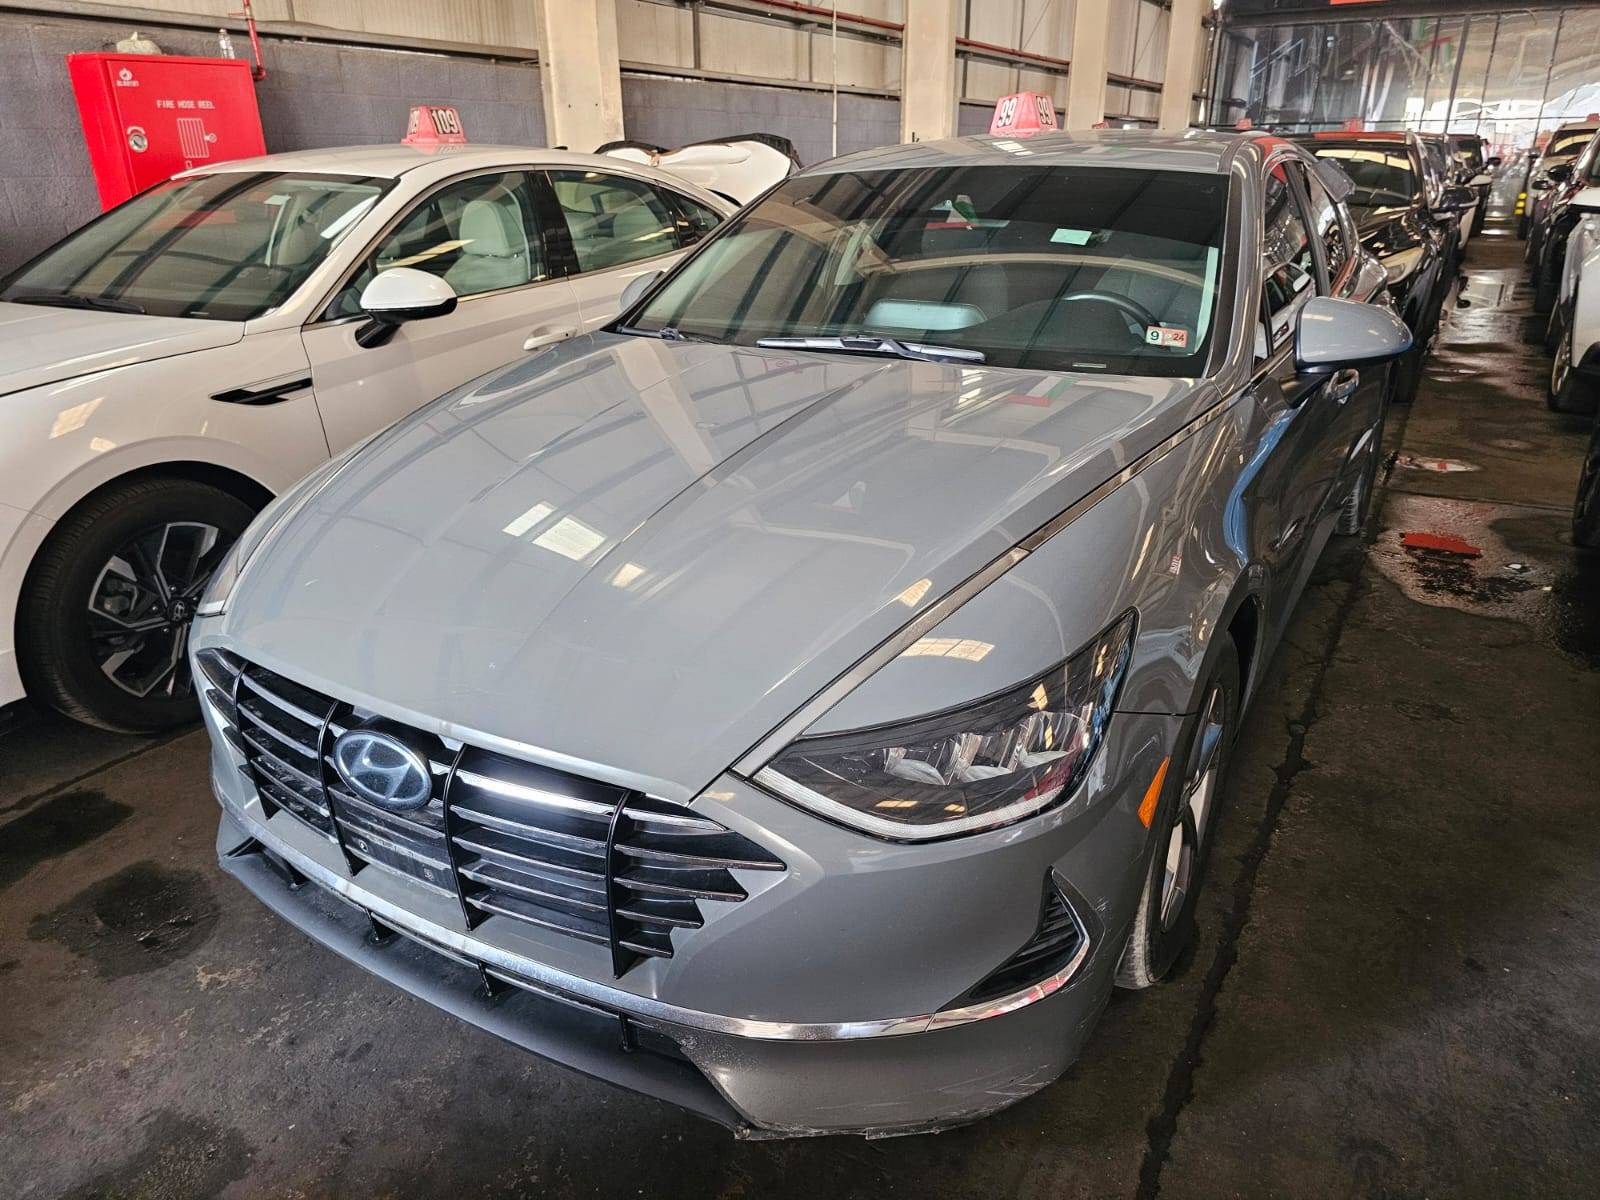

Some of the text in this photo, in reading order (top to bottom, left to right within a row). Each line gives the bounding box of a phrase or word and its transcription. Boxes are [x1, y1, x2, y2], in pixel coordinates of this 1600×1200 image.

[156, 99, 216, 110] FIRE HOSE REEL
[997, 97, 1018, 127] 99
[1036, 96, 1053, 125] 99
[431, 109, 460, 134] 109
[1150, 330, 1185, 342] 9 24
